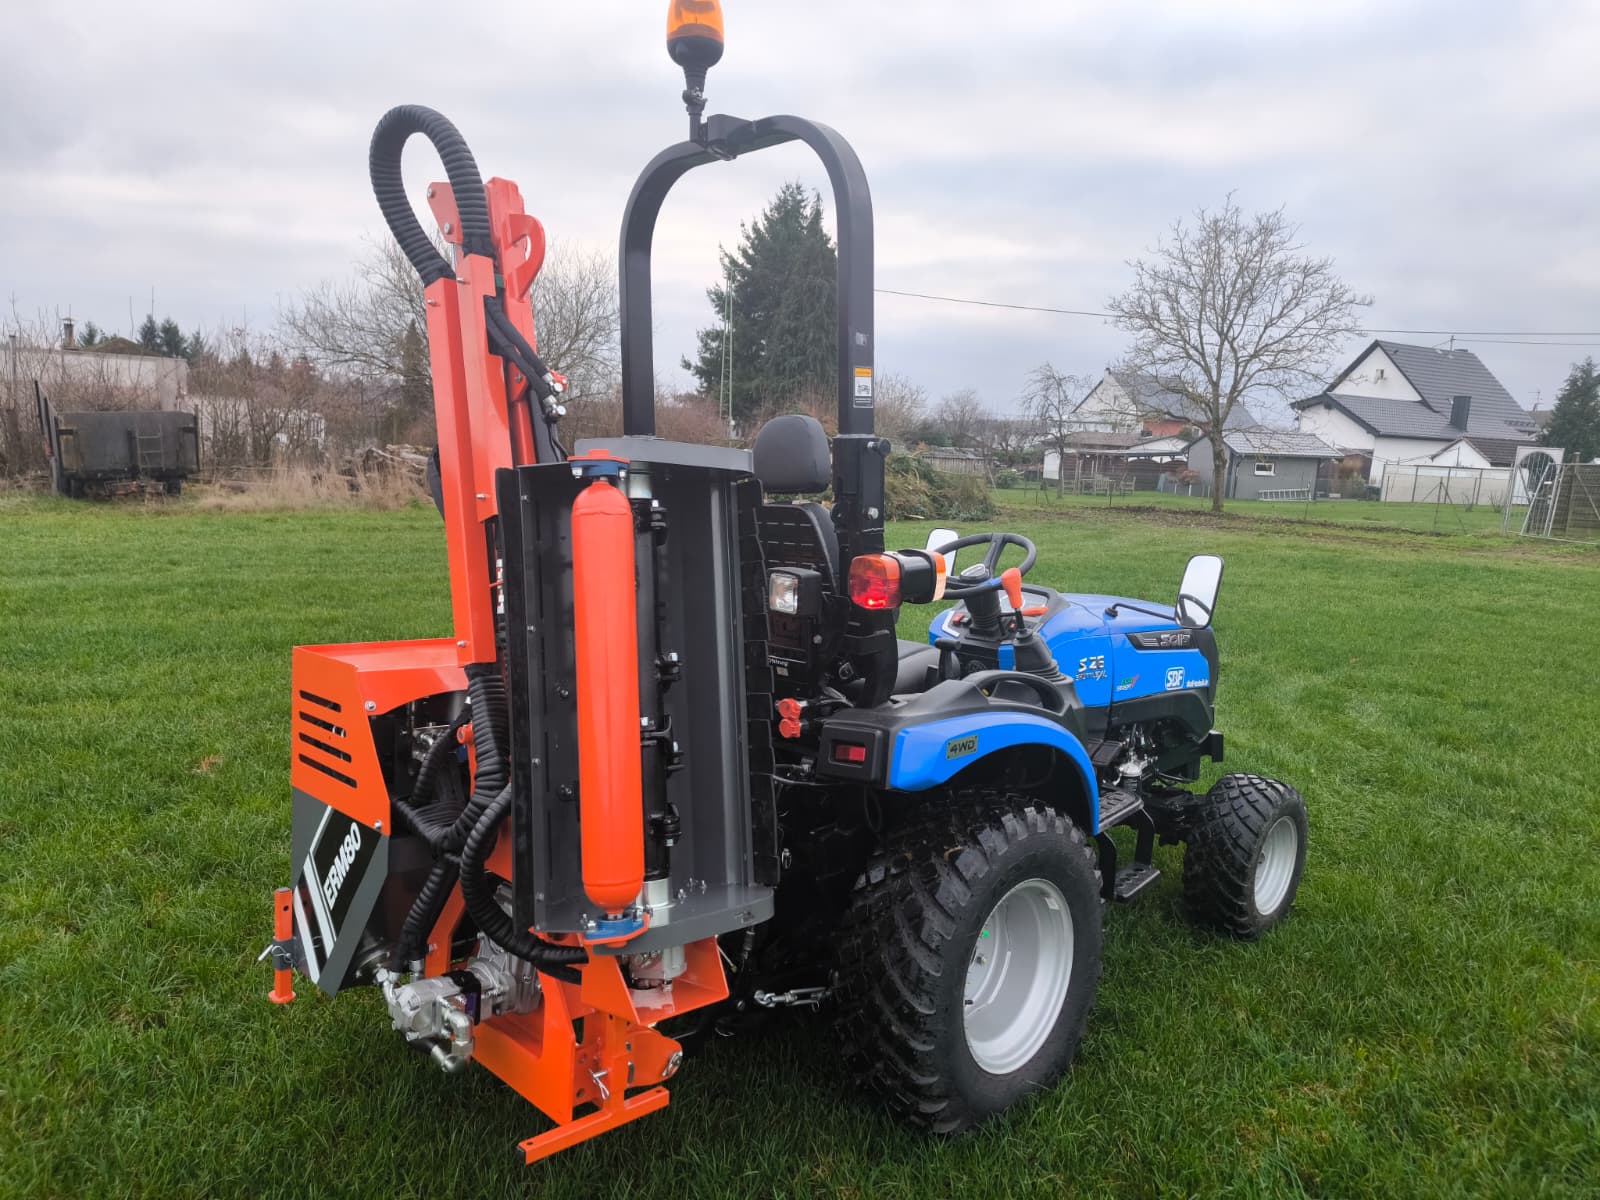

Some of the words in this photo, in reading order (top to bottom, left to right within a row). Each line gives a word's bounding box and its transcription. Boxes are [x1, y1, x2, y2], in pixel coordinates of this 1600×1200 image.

[1166, 669, 1184, 688] SDF
[950, 740, 976, 754] 4WD
[323, 821, 362, 911] ERM80
